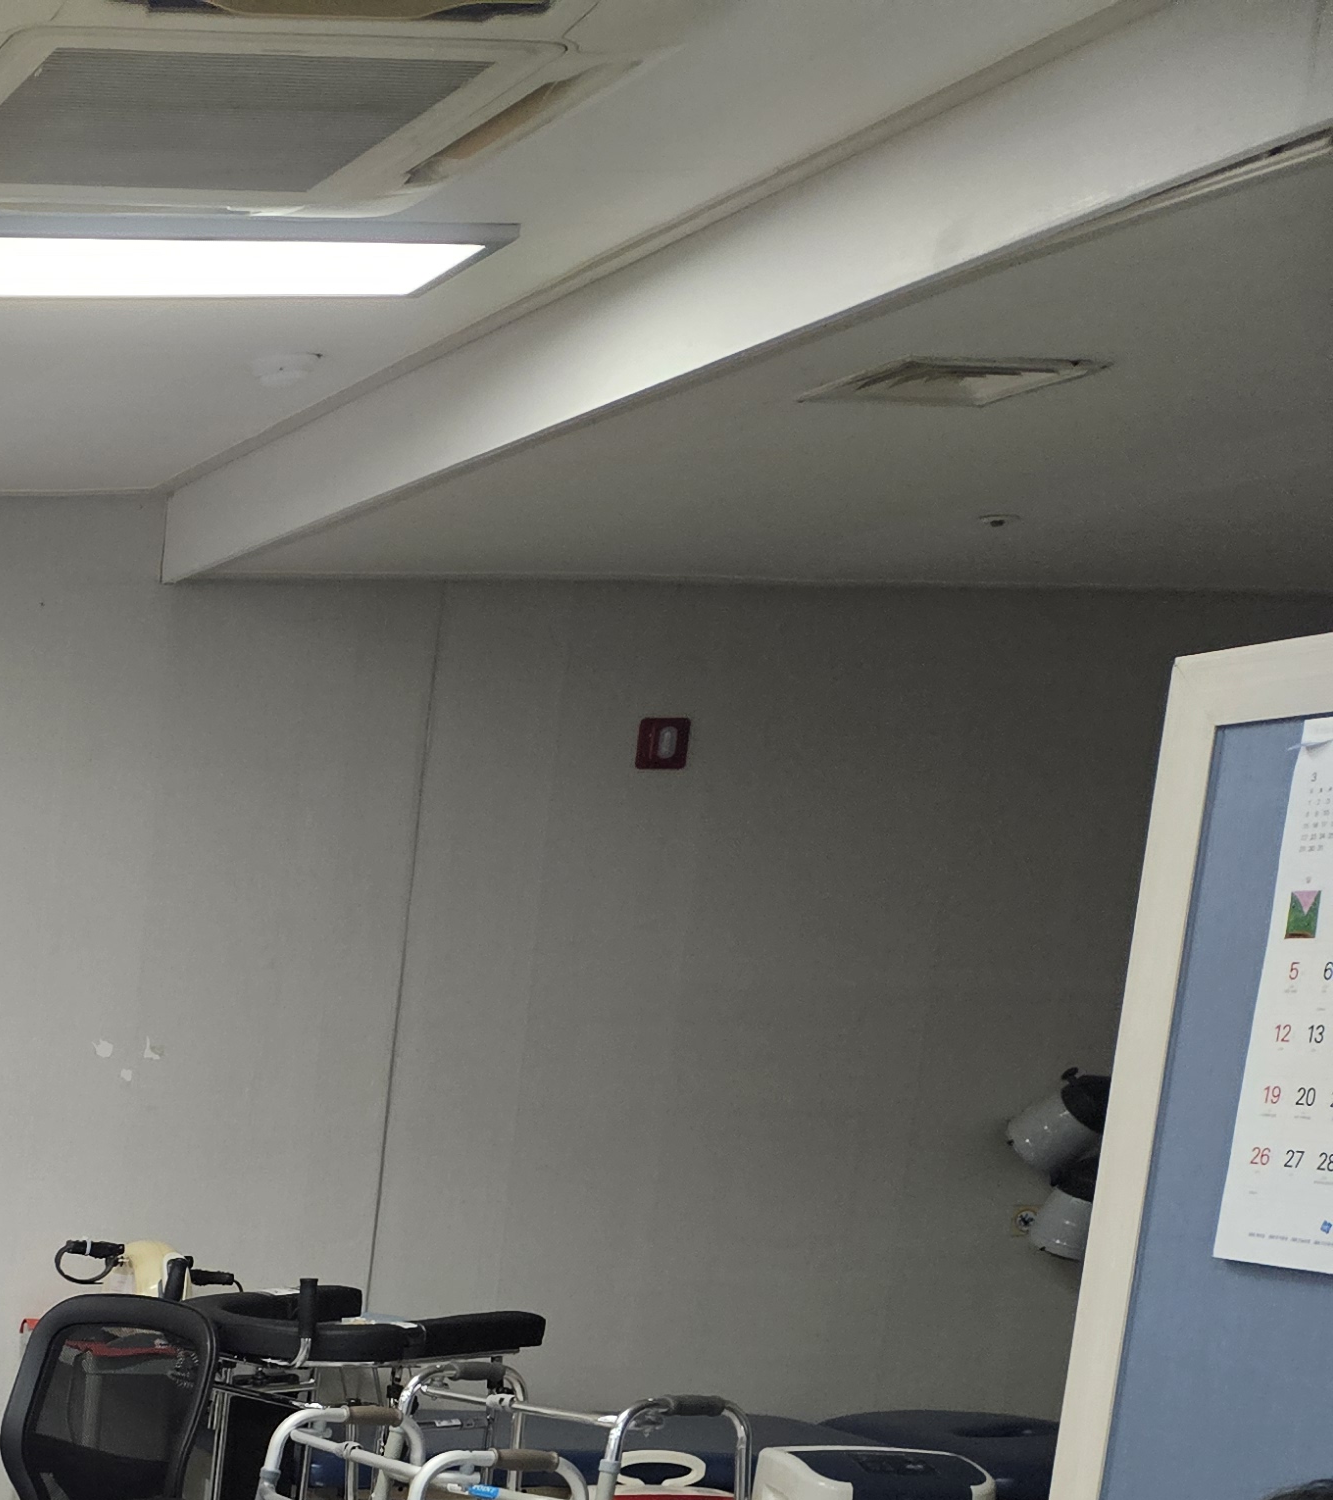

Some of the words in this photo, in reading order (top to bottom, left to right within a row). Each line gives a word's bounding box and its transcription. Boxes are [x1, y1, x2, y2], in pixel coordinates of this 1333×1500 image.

[1288, 962, 1300, 980] 5
[1323, 962, 1333, 980] 6
[1274, 1024, 1292, 1043] 12
[1308, 1024, 1325, 1044] 13
[1263, 1086, 1282, 1104] 19
[1295, 1087, 1316, 1107] 20
[1250, 1147, 1271, 1166] 26
[1284, 1150, 1305, 1169] 27
[1317, 1152, 1333, 1172] 28
